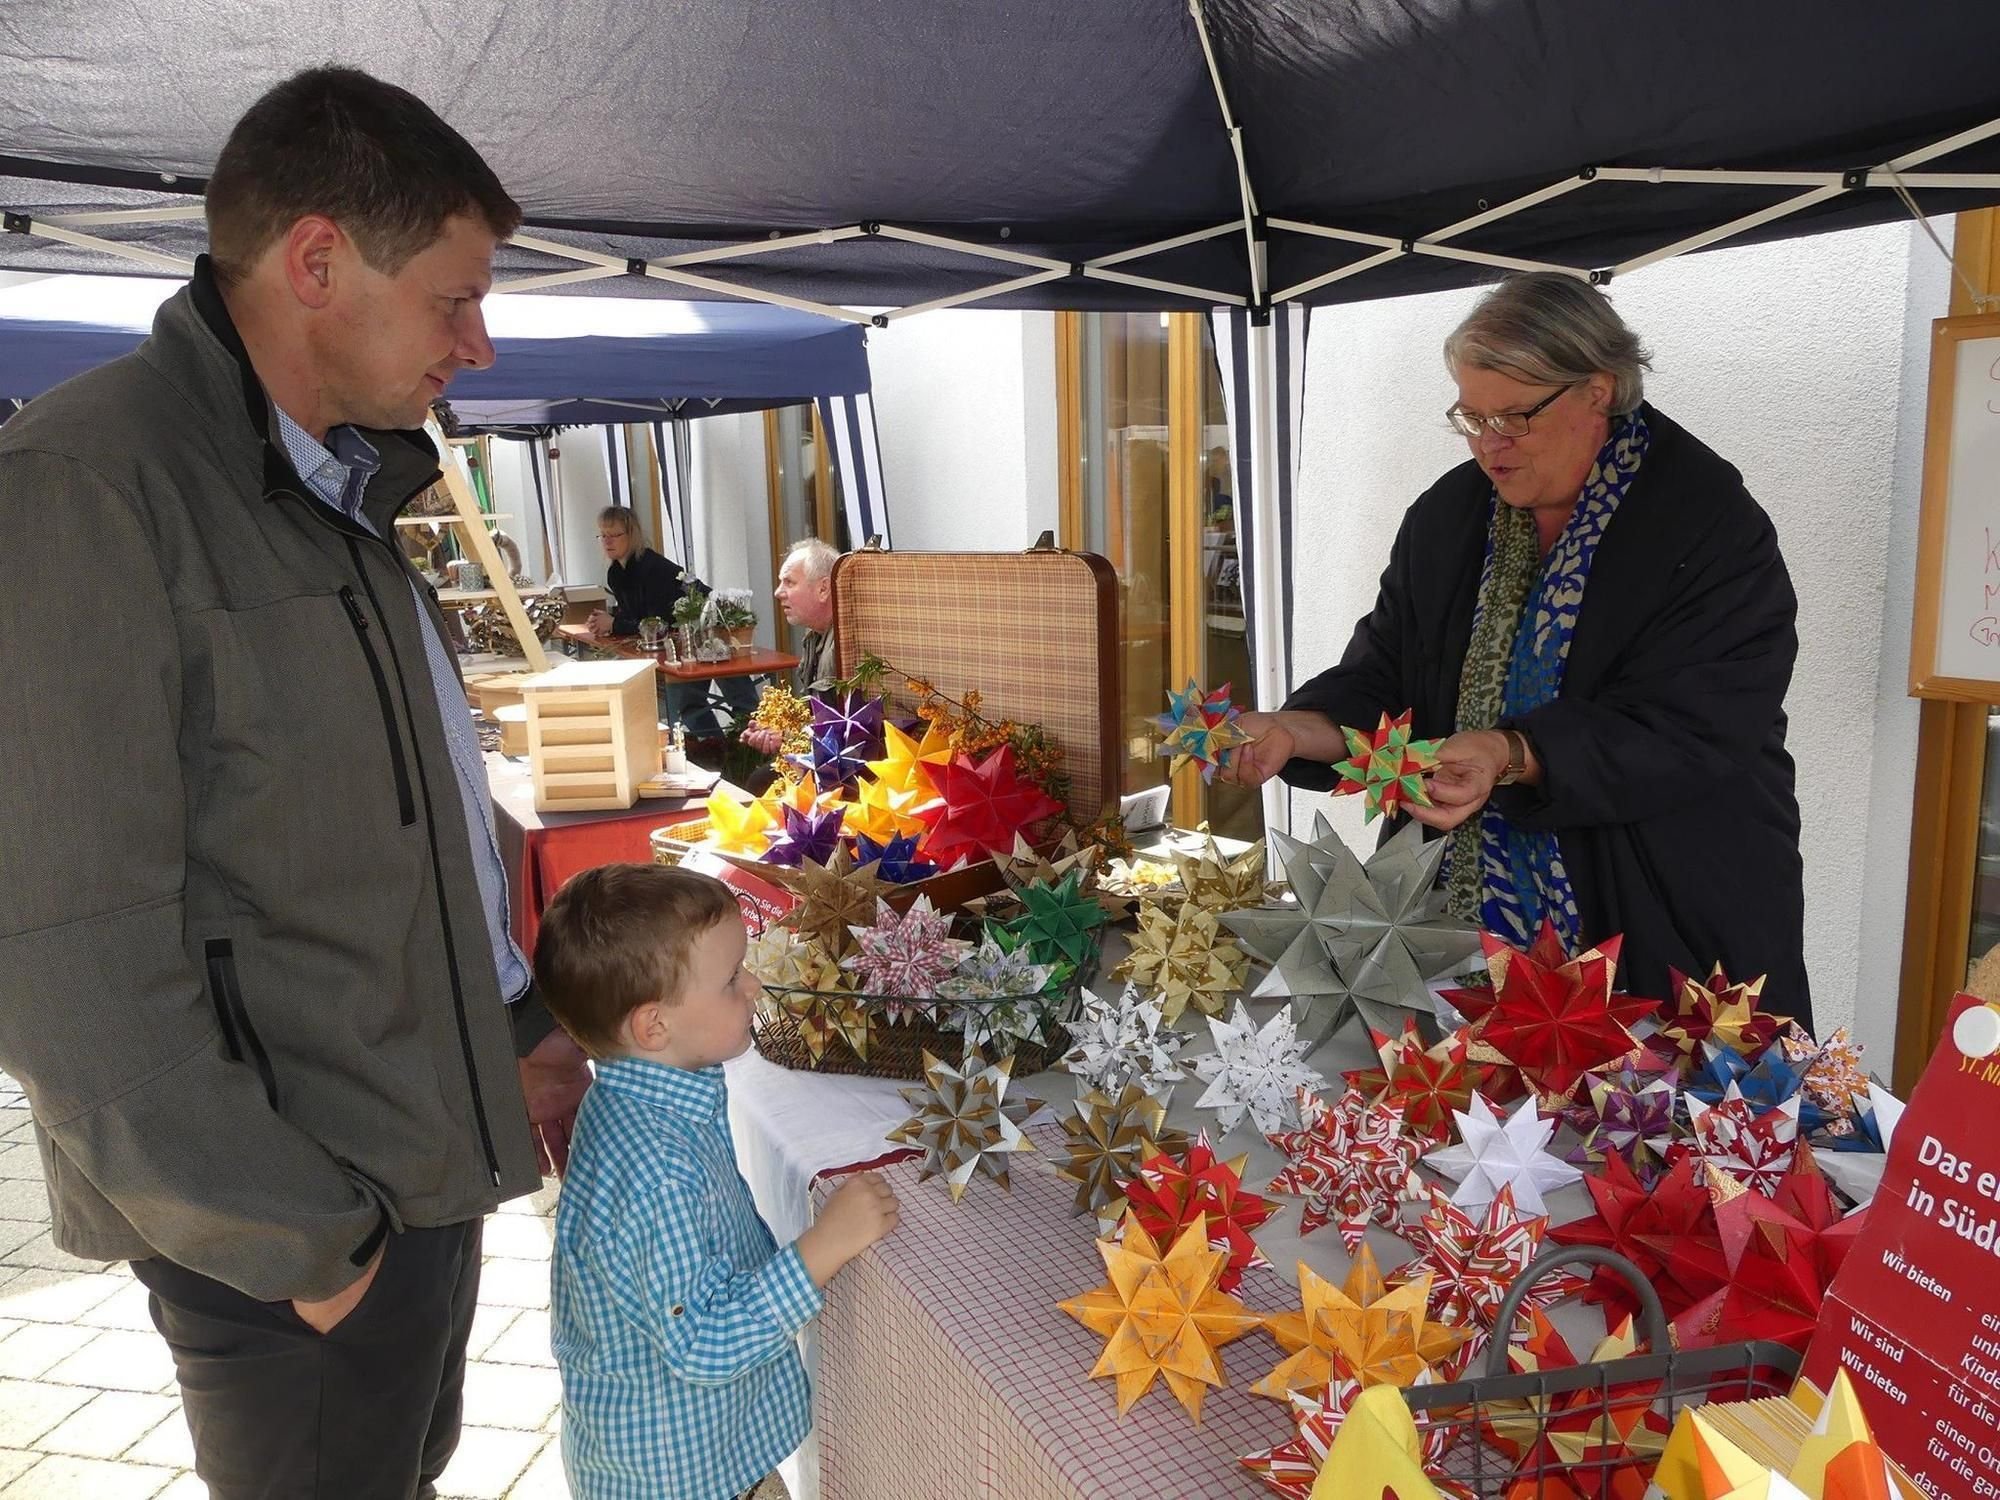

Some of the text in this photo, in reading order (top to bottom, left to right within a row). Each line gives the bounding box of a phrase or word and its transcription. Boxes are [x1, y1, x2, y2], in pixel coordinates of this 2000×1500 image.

[1918, 1135, 1972, 1184] Das
[1906, 1178, 1935, 1217] in
[1881, 1249, 1907, 1274] Wir
[1906, 1265, 1952, 1302] bieten
[1851, 1316, 1874, 1342] Wir
[1874, 1338, 1904, 1363] sind
[1948, 1383, 1971, 1408] für
[1971, 1402, 1995, 1426] die
[1972, 1334, 2000, 1362] unh
[1840, 1347, 1865, 1372] Wir
[1864, 1366, 1908, 1404] bieten
[1935, 1419, 1976, 1454] einen
[1927, 1437, 1950, 1461] für
[1950, 1457, 1974, 1481] die
[1914, 1471, 1940, 1497] das
